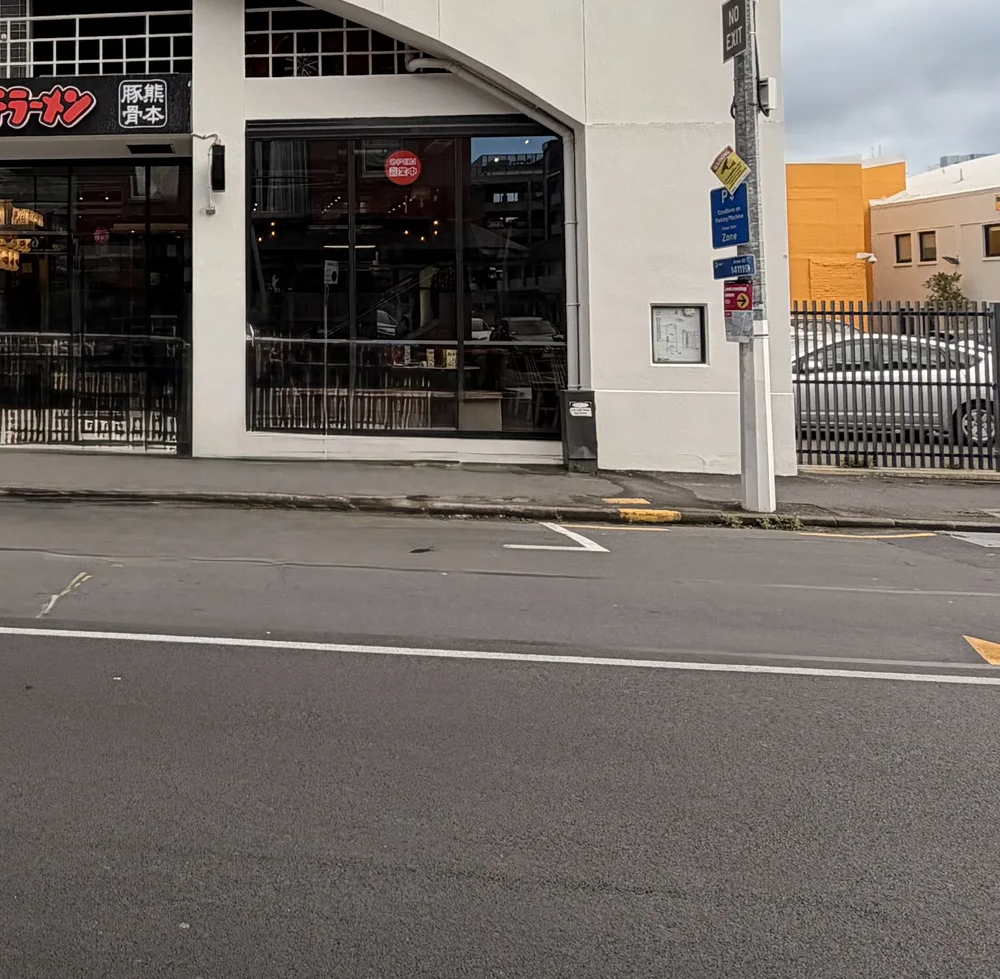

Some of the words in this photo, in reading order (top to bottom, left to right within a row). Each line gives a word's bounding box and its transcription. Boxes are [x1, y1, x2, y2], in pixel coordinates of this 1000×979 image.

[728, 5, 740, 27] NO
[726, 25, 743, 51] EXIT
[722, 233, 738, 242] Zone
